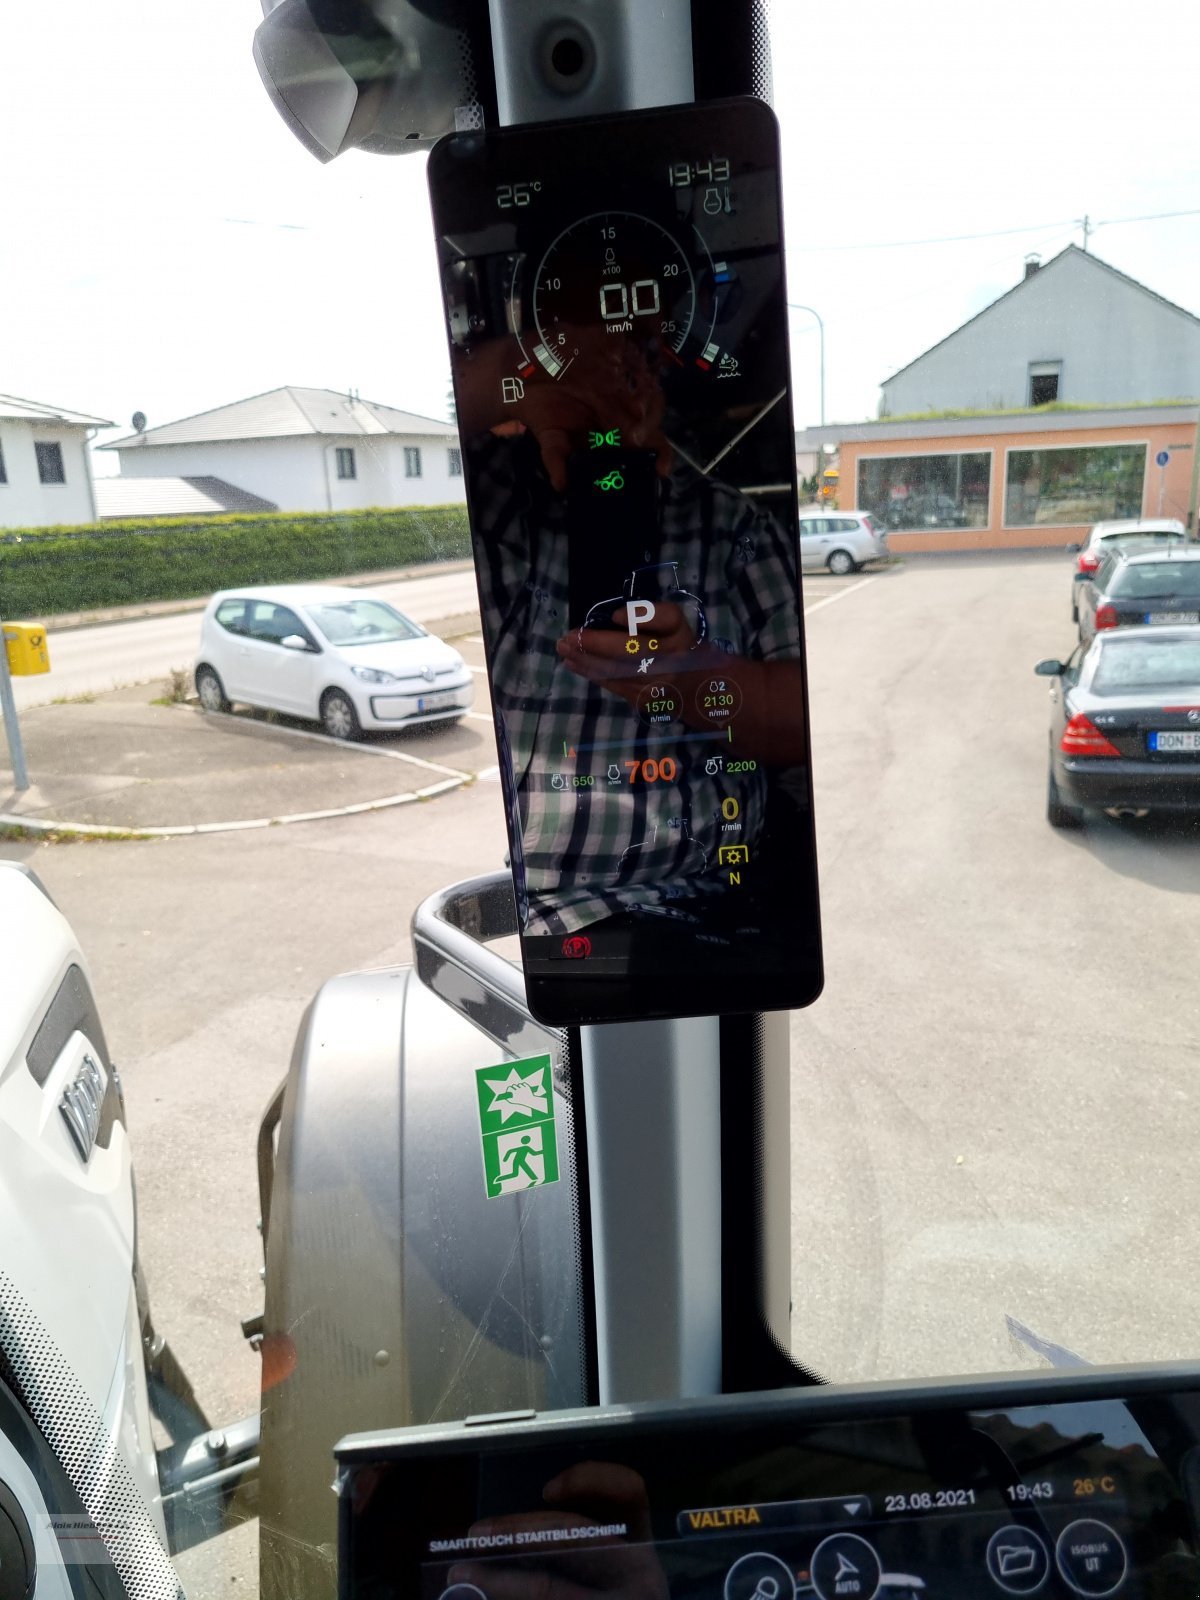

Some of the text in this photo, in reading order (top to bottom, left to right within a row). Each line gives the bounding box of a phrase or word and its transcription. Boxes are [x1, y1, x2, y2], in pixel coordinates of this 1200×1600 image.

[668, 158, 731, 187] 19:43
[601, 226, 616, 240] 15
[663, 264, 679, 277] 20
[545, 278, 561, 292] 10
[599, 279, 661, 320] 0.0
[605, 321, 633, 334] km/h
[660, 320, 676, 333] 25
[558, 333, 566, 345] 5
[626, 599, 656, 637] P
[648, 639, 658, 650] C
[719, 681, 726, 691] 2
[645, 700, 675, 713] 1570
[704, 694, 734, 708] 2130
[708, 708, 730, 718] n/min
[625, 757, 676, 784] 700
[726, 760, 757, 773] 2200
[572, 775, 595, 787] 650
[722, 797, 739, 821] 0
[721, 822, 742, 832] r/min
[729, 871, 741, 885] N
[1007, 1481, 1053, 1501] 19:43
[885, 1489, 976, 1513] 23.08.2021
[688, 1507, 761, 1530] VALTRA
[429, 1523, 627, 1552] SMARTTOUCH STARTBILDSCHIRM
[835, 1580, 860, 1593] AUTO
